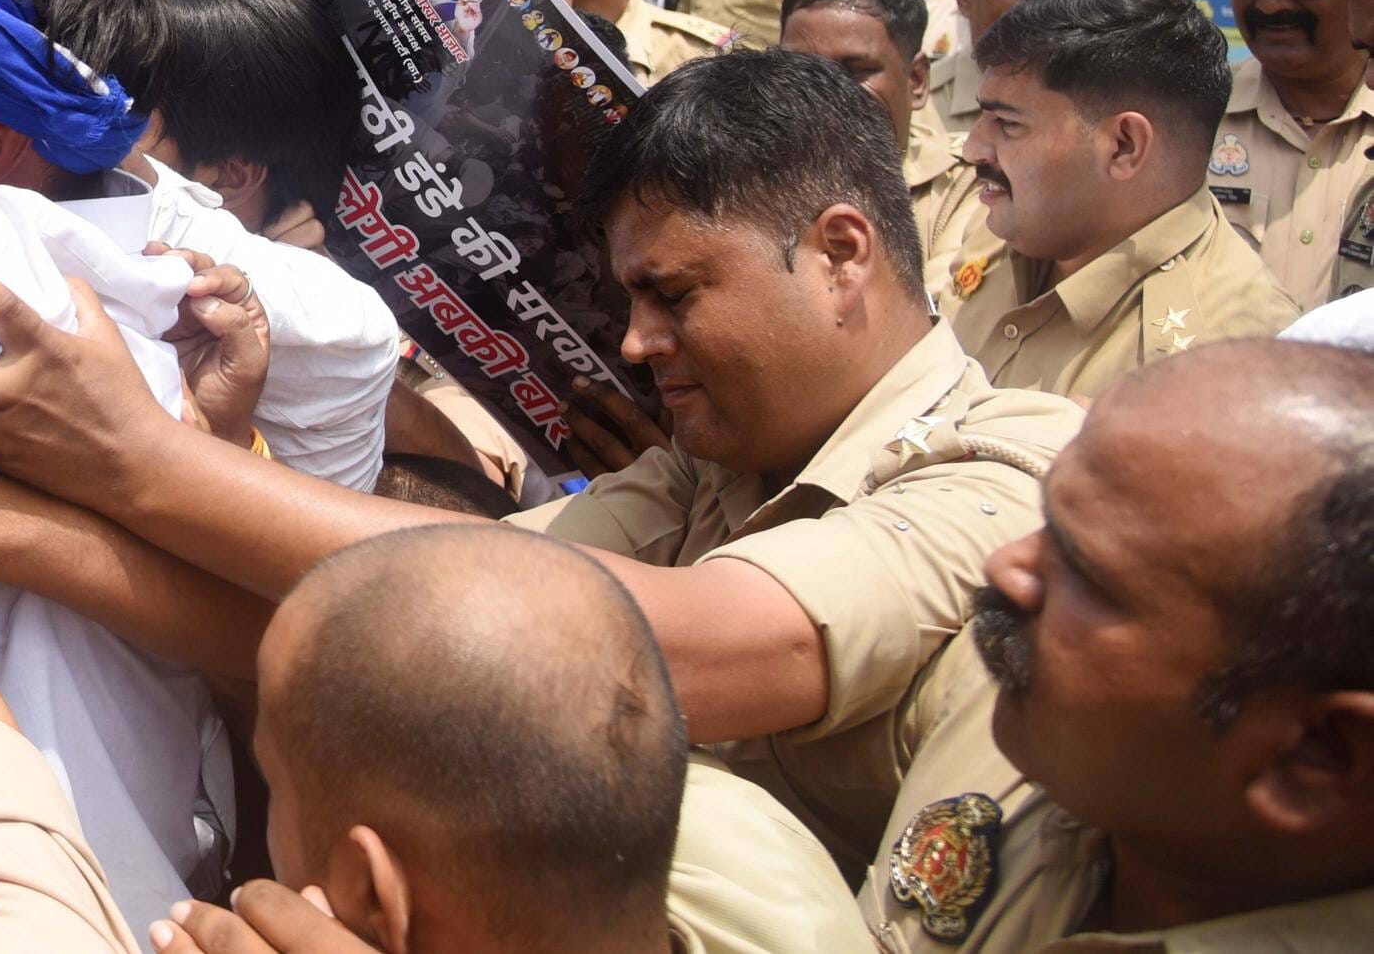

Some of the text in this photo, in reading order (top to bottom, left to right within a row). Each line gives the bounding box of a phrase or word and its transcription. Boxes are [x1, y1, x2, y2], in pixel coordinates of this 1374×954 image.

[373, 6, 395, 36] समाज
[391, 34, 411, 58] पार्टी
[397, 20, 422, 52] अध्यक्ष
[410, 13, 433, 43] सांसद
[393, 150, 464, 218] डंडे
[450, 216, 521, 282] की
[506, 279, 634, 402] सरका
[393, 262, 530, 378] अबकी
